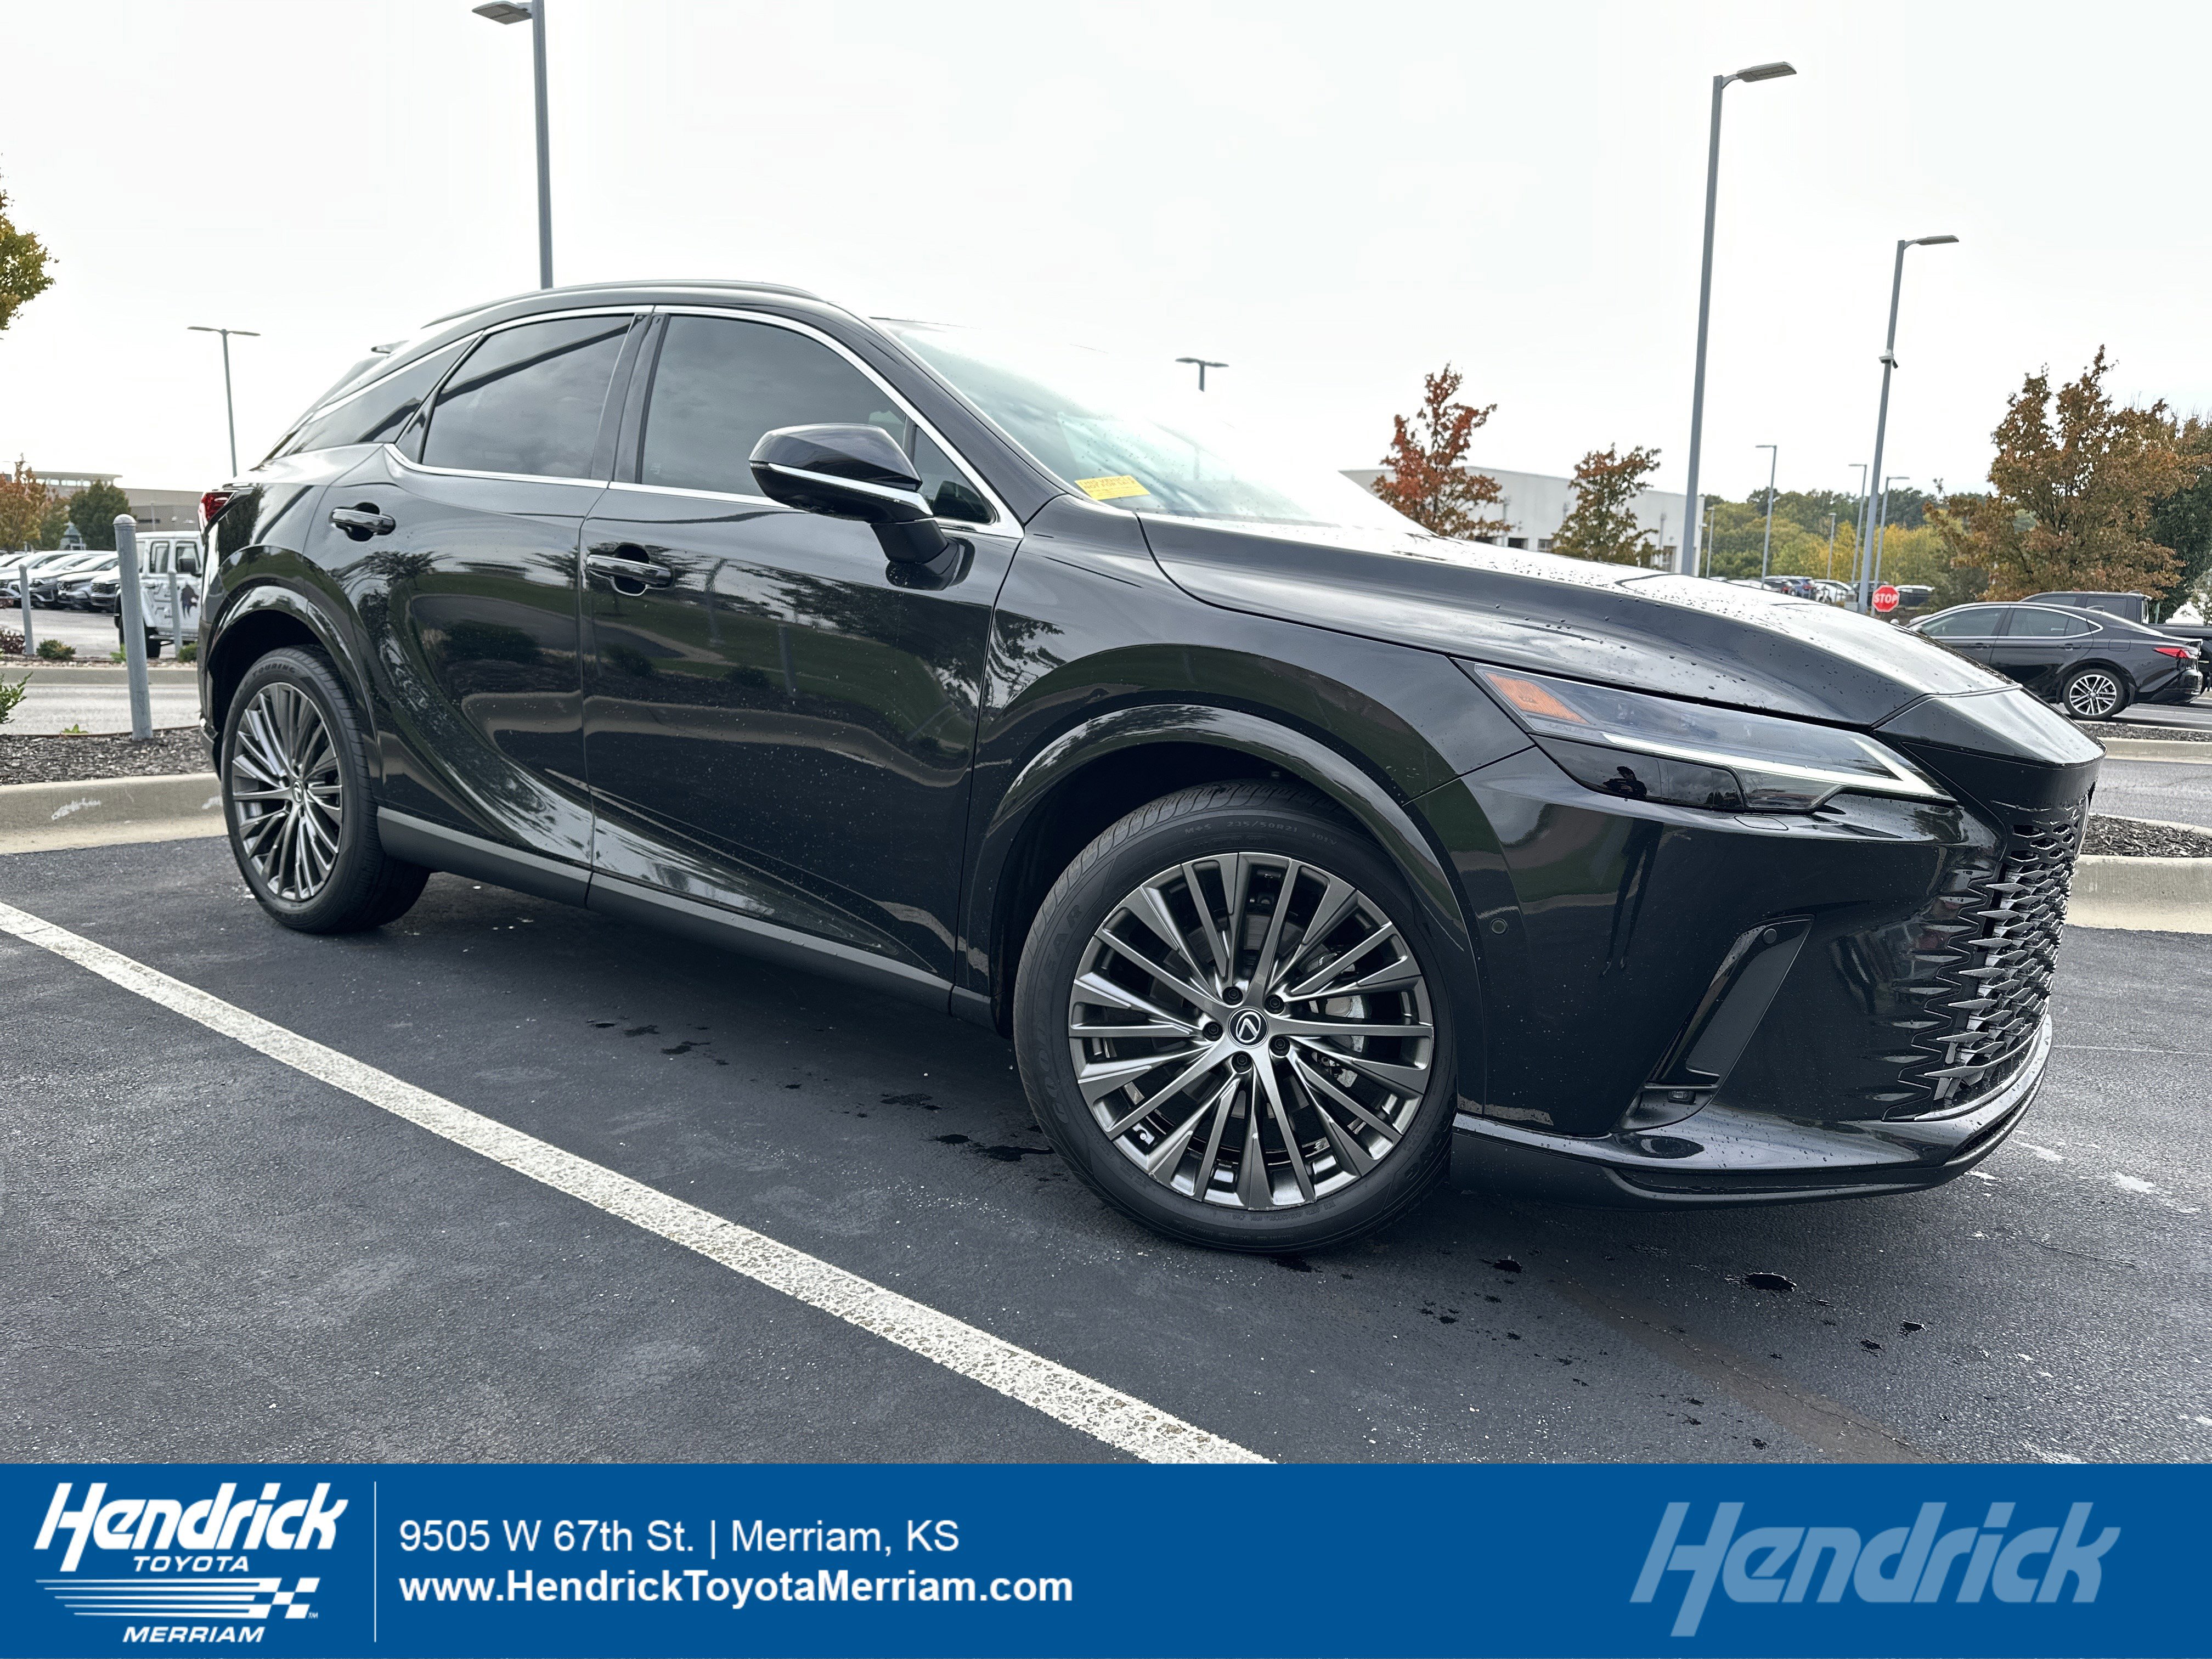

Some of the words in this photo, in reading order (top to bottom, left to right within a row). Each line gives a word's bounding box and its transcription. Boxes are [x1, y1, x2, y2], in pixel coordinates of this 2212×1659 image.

[1874, 593, 1898, 604] STOP
[1184, 823, 1212, 834] M+S
[1227, 821, 1298, 833] 235/50R21
